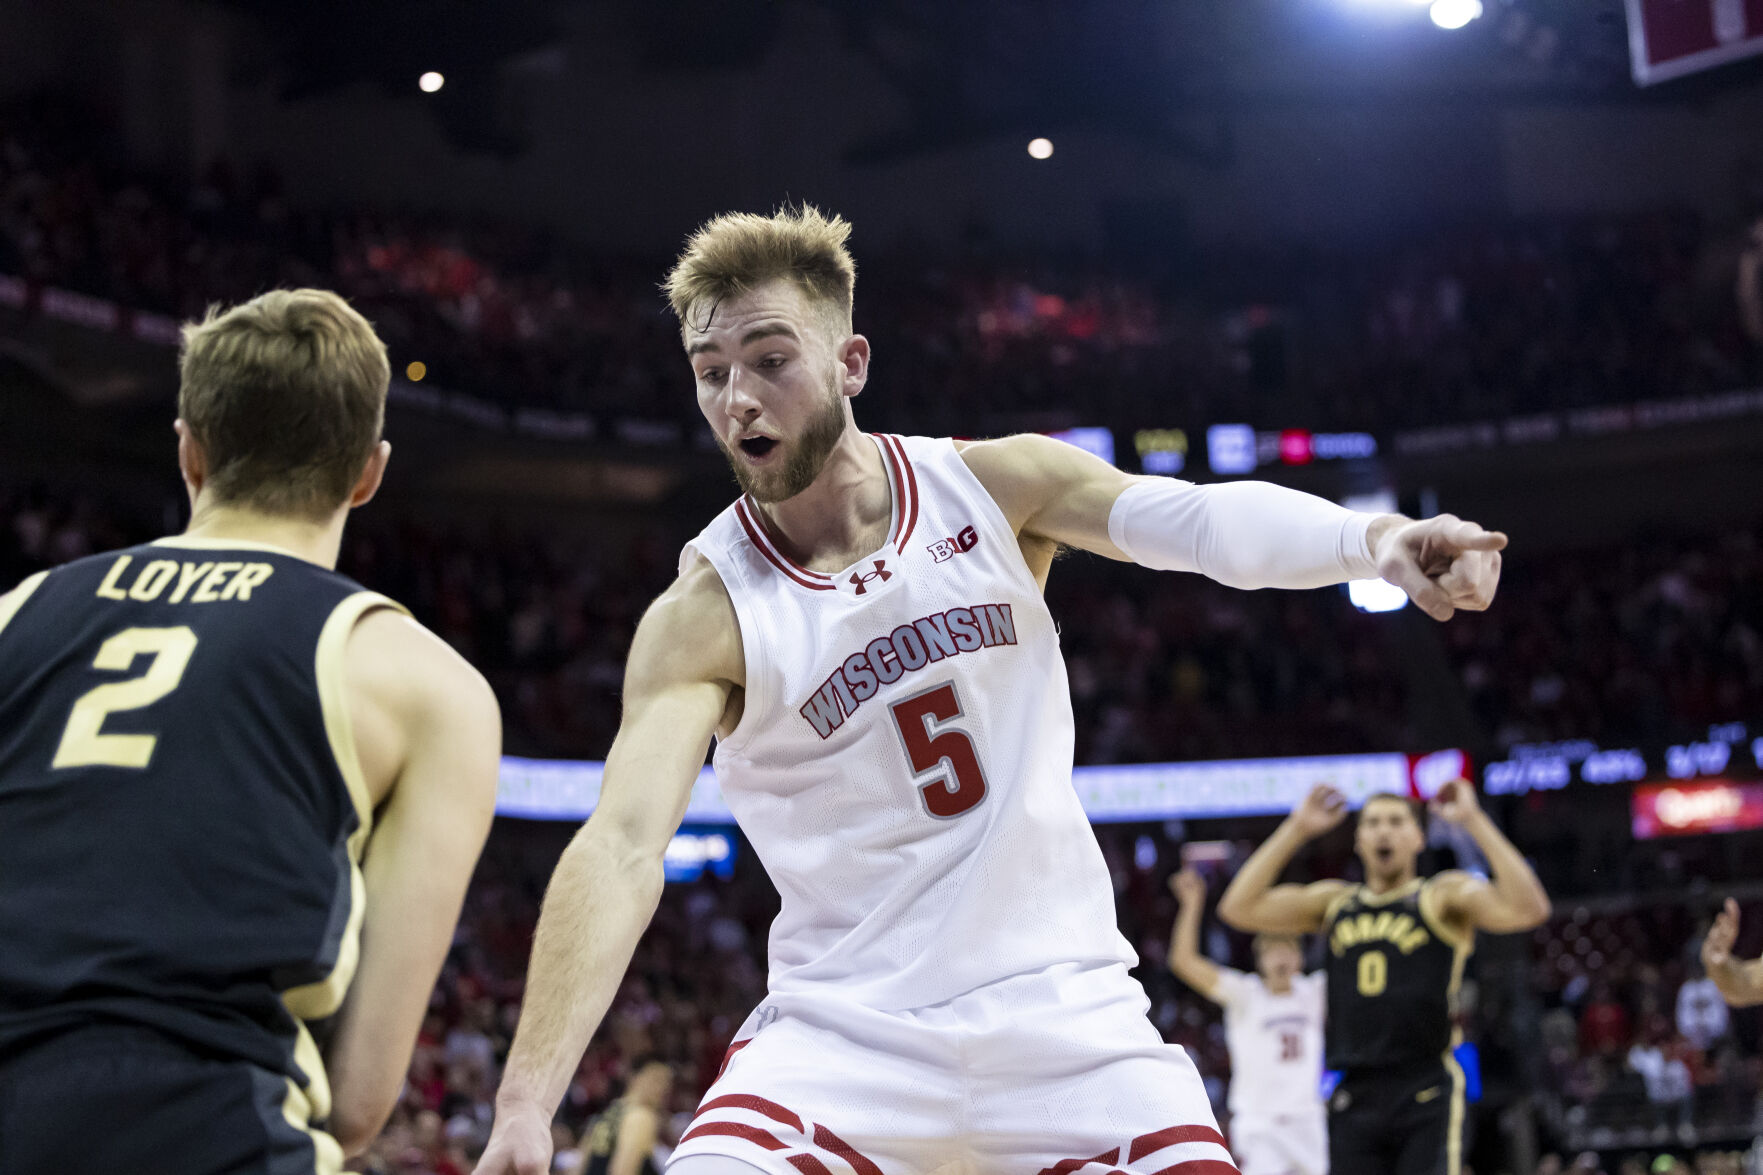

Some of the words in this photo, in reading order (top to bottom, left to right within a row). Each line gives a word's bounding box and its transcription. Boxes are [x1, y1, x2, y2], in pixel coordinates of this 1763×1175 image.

[96, 555, 274, 604] LOYER
[52, 625, 198, 769] 2
[800, 603, 1018, 740] WISCONSIN
[887, 679, 990, 821] 5
[1357, 950, 1388, 997] 0
